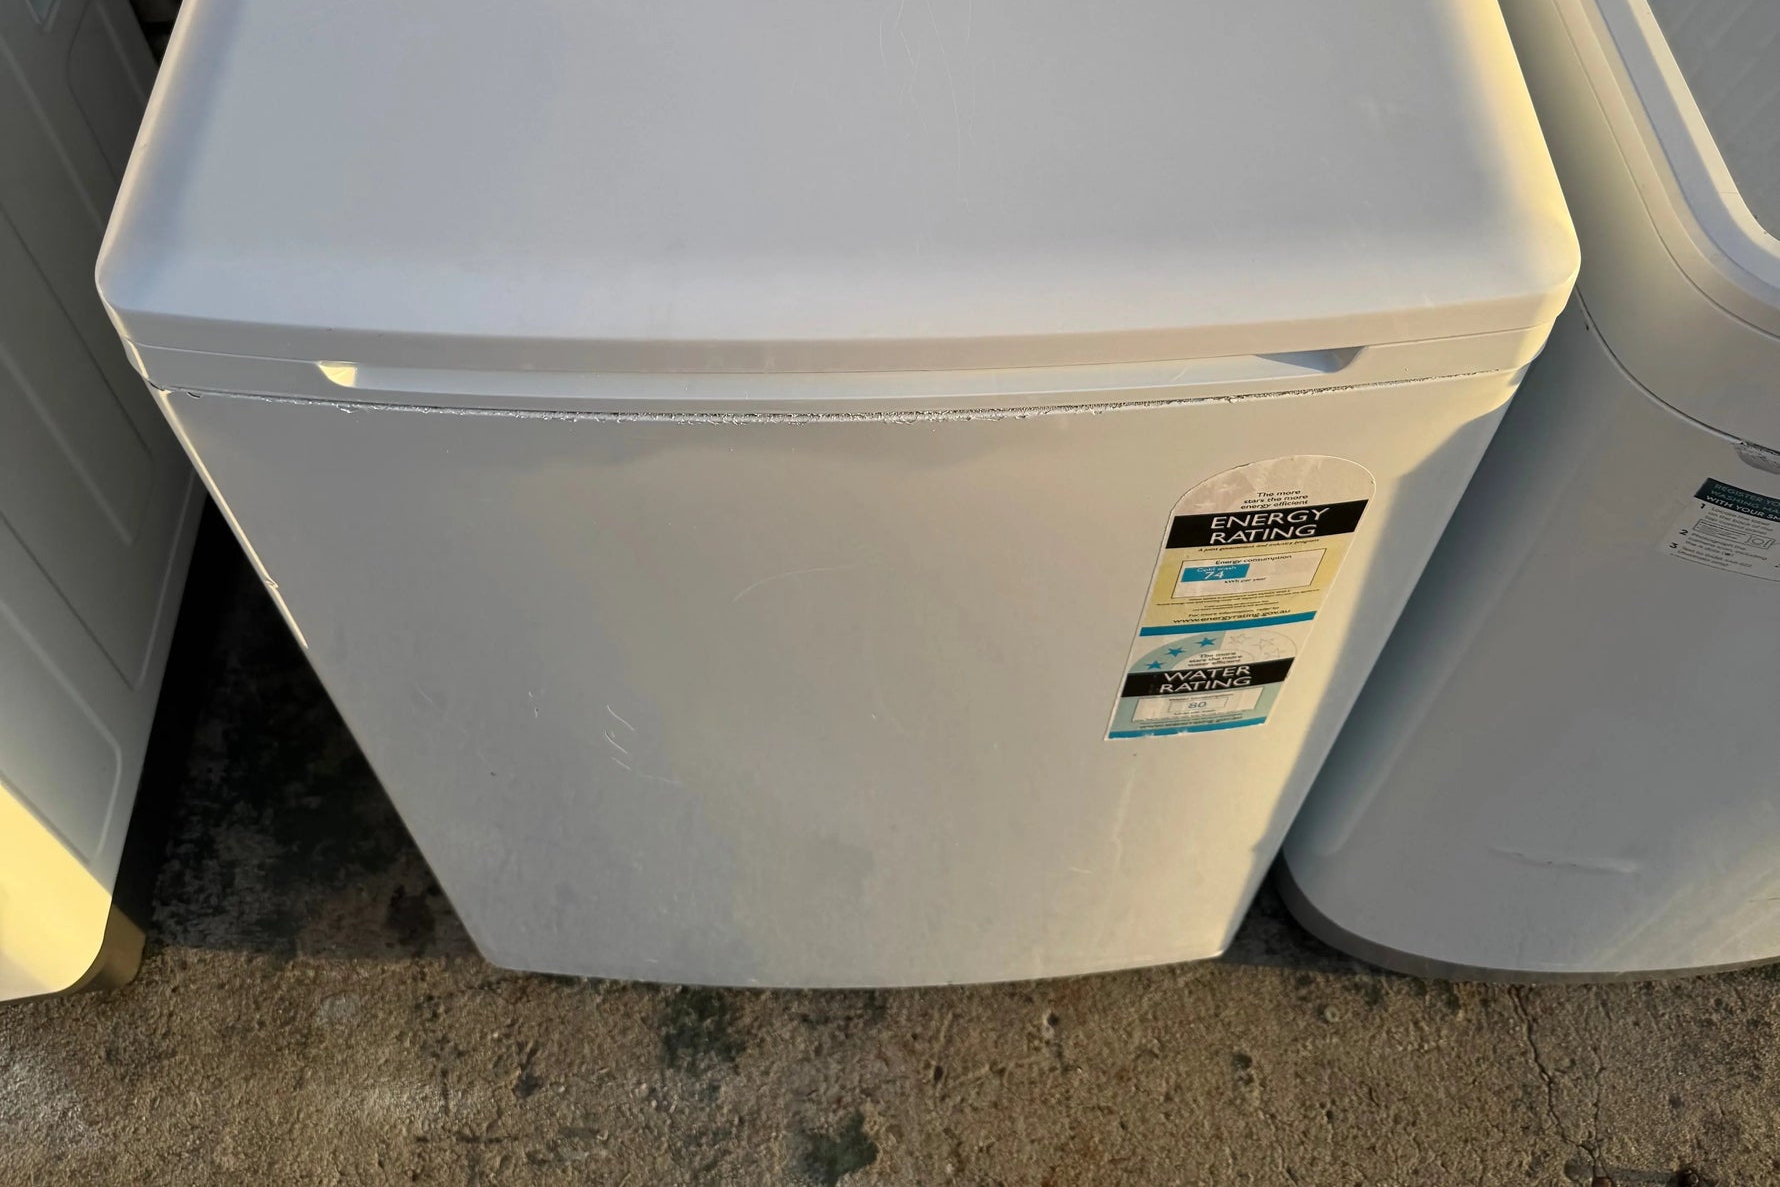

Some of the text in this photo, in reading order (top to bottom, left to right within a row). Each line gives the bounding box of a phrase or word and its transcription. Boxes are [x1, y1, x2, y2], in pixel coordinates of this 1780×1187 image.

[1707, 495, 1733, 508] WITH
[1736, 505, 1765, 516] YOUR
[1211, 507, 1330, 529] ENERGY
[1210, 524, 1318, 544] RATING
[1243, 555, 1292, 563] consumption
[1204, 571, 1224, 580] 74
[1164, 666, 1250, 681] WATER
[1160, 677, 1252, 693] RATING
